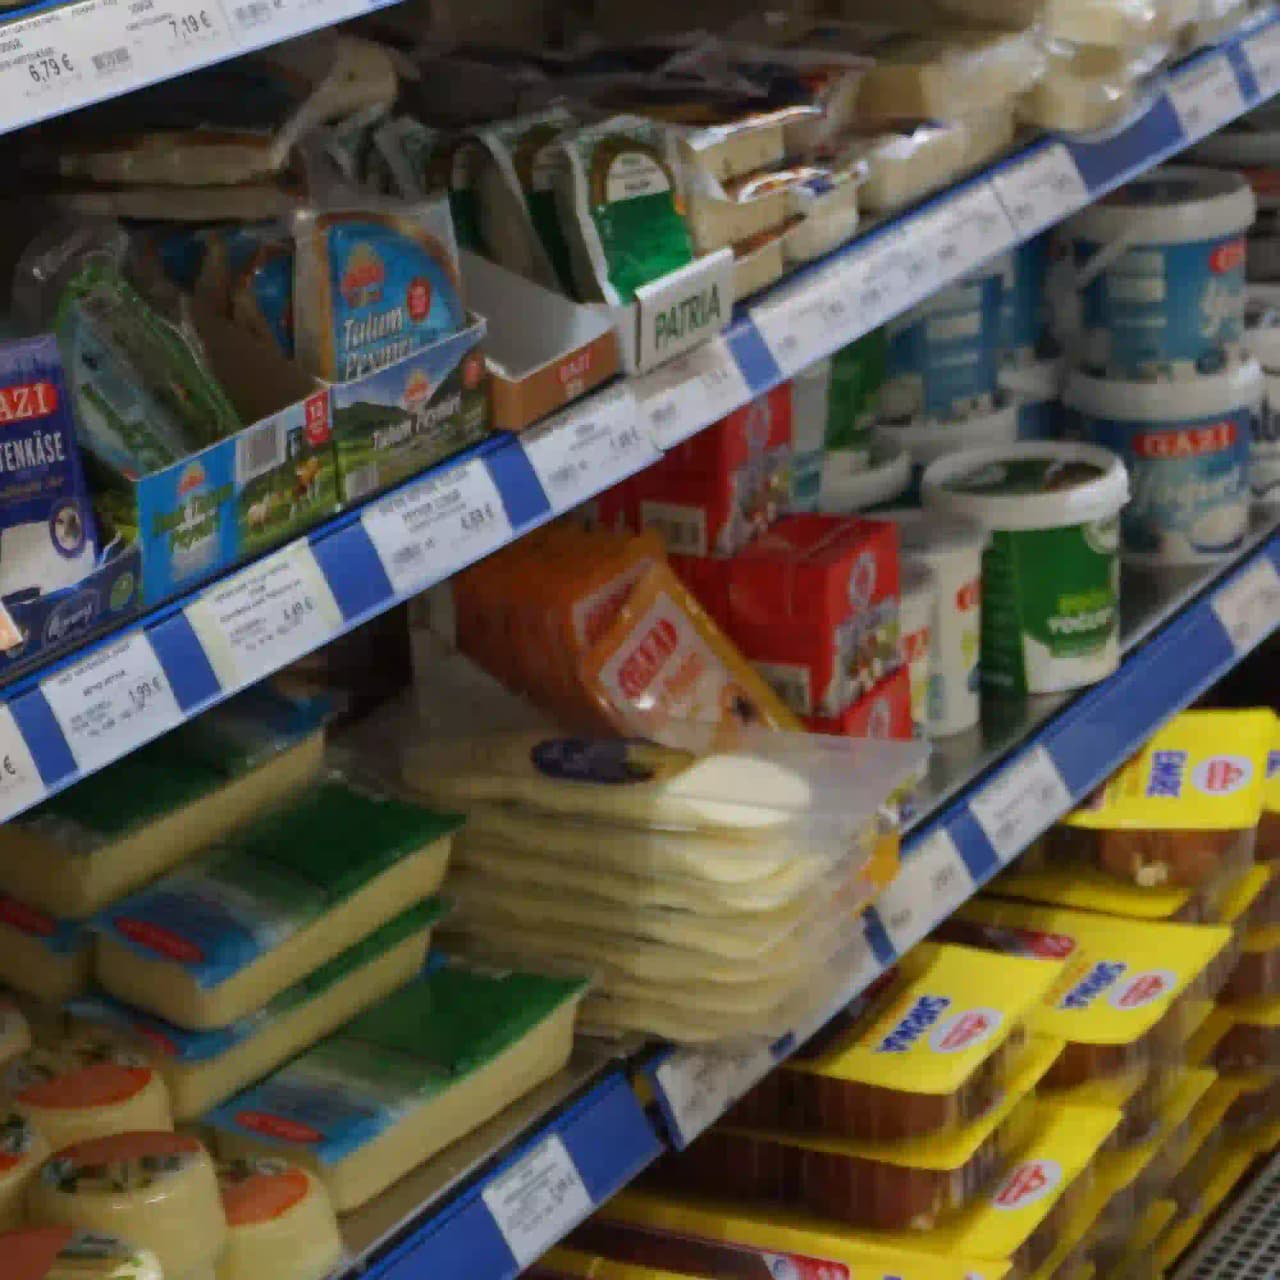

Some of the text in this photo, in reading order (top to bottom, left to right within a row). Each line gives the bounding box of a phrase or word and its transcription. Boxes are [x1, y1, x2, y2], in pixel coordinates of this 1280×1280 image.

[199, 9, 212, 28] €
[61, 52, 74, 72] €
[654, 285, 722, 351] PATRIA
[3, 754, 17, 777] €
